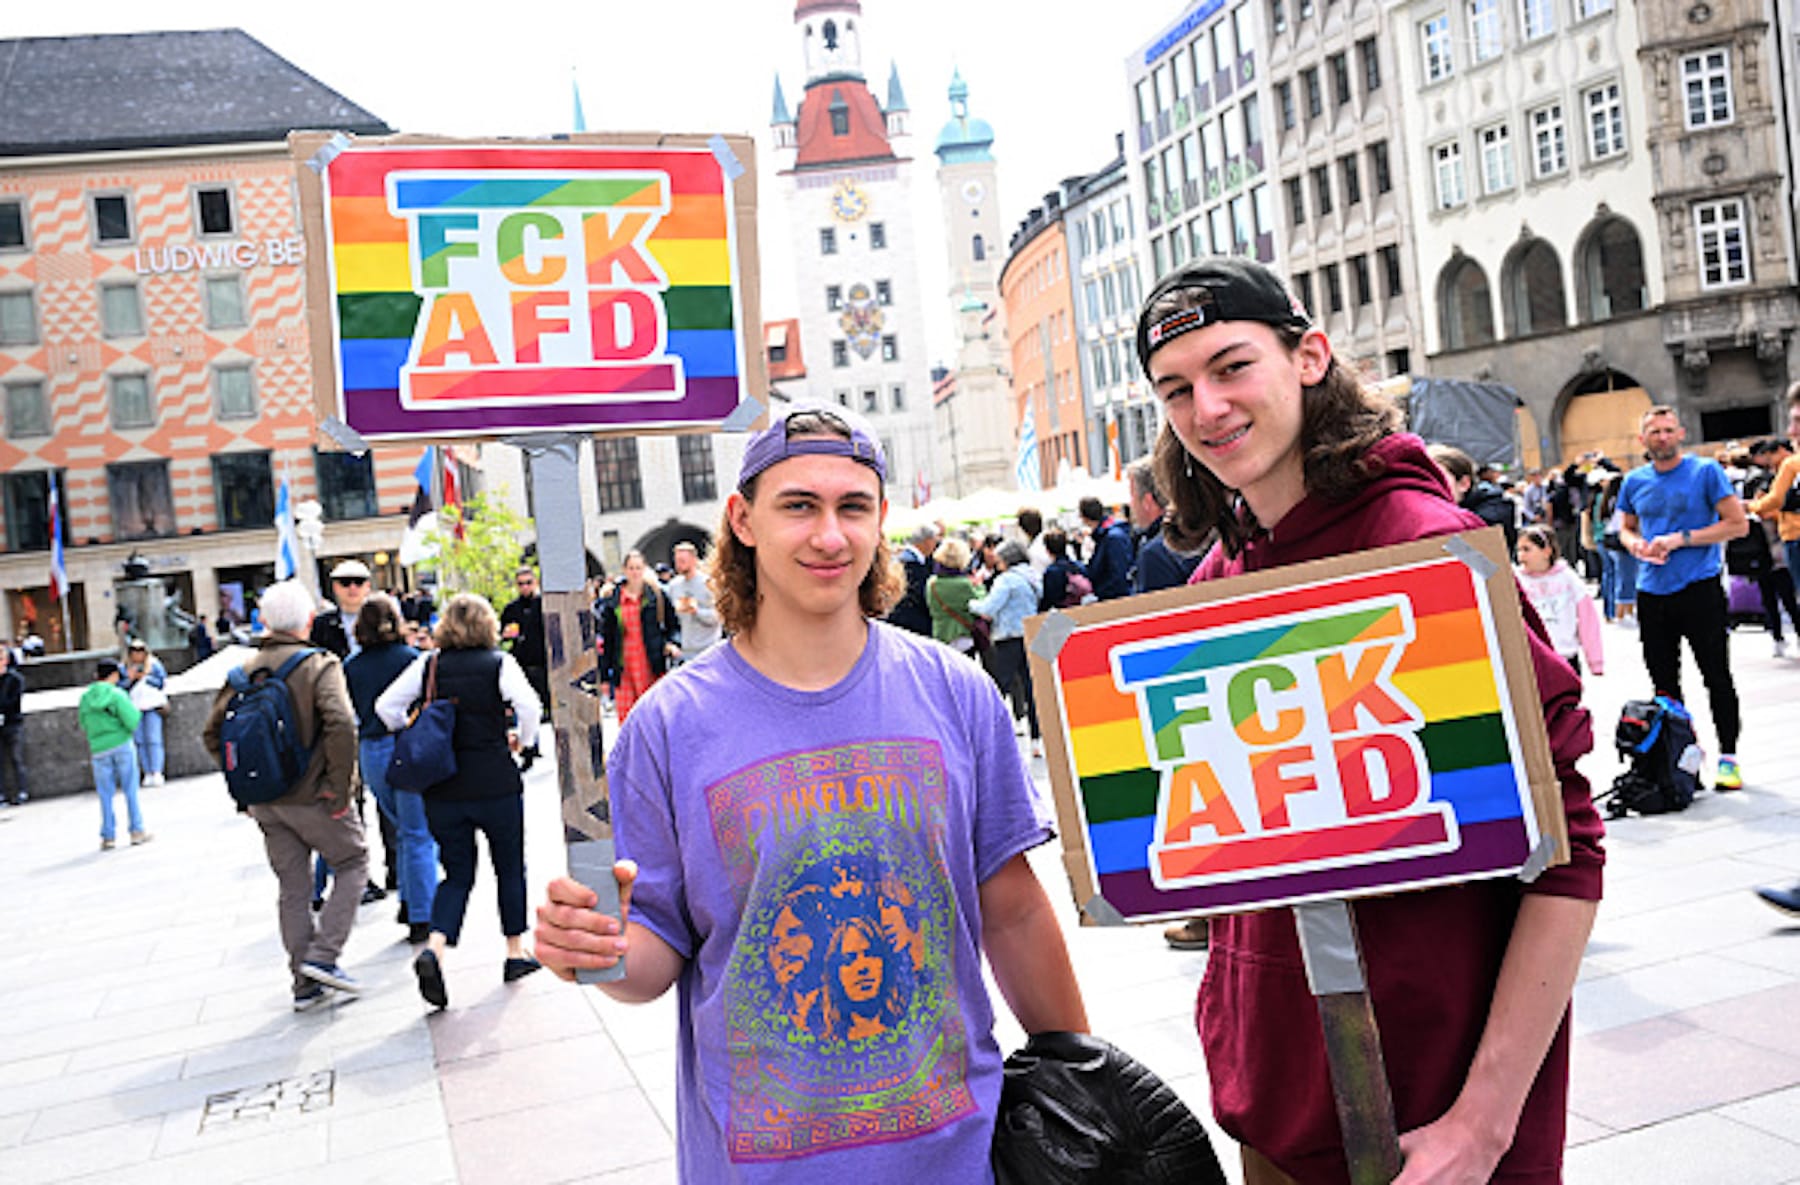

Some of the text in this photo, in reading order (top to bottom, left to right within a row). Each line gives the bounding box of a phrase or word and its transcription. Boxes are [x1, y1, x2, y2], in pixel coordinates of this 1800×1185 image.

[134, 237, 307, 275] LUDWIG BE
[418, 212, 661, 288] FCK
[416, 290, 658, 367] AFD
[1146, 642, 1415, 761] FCK
[1164, 733, 1420, 845] AFD
